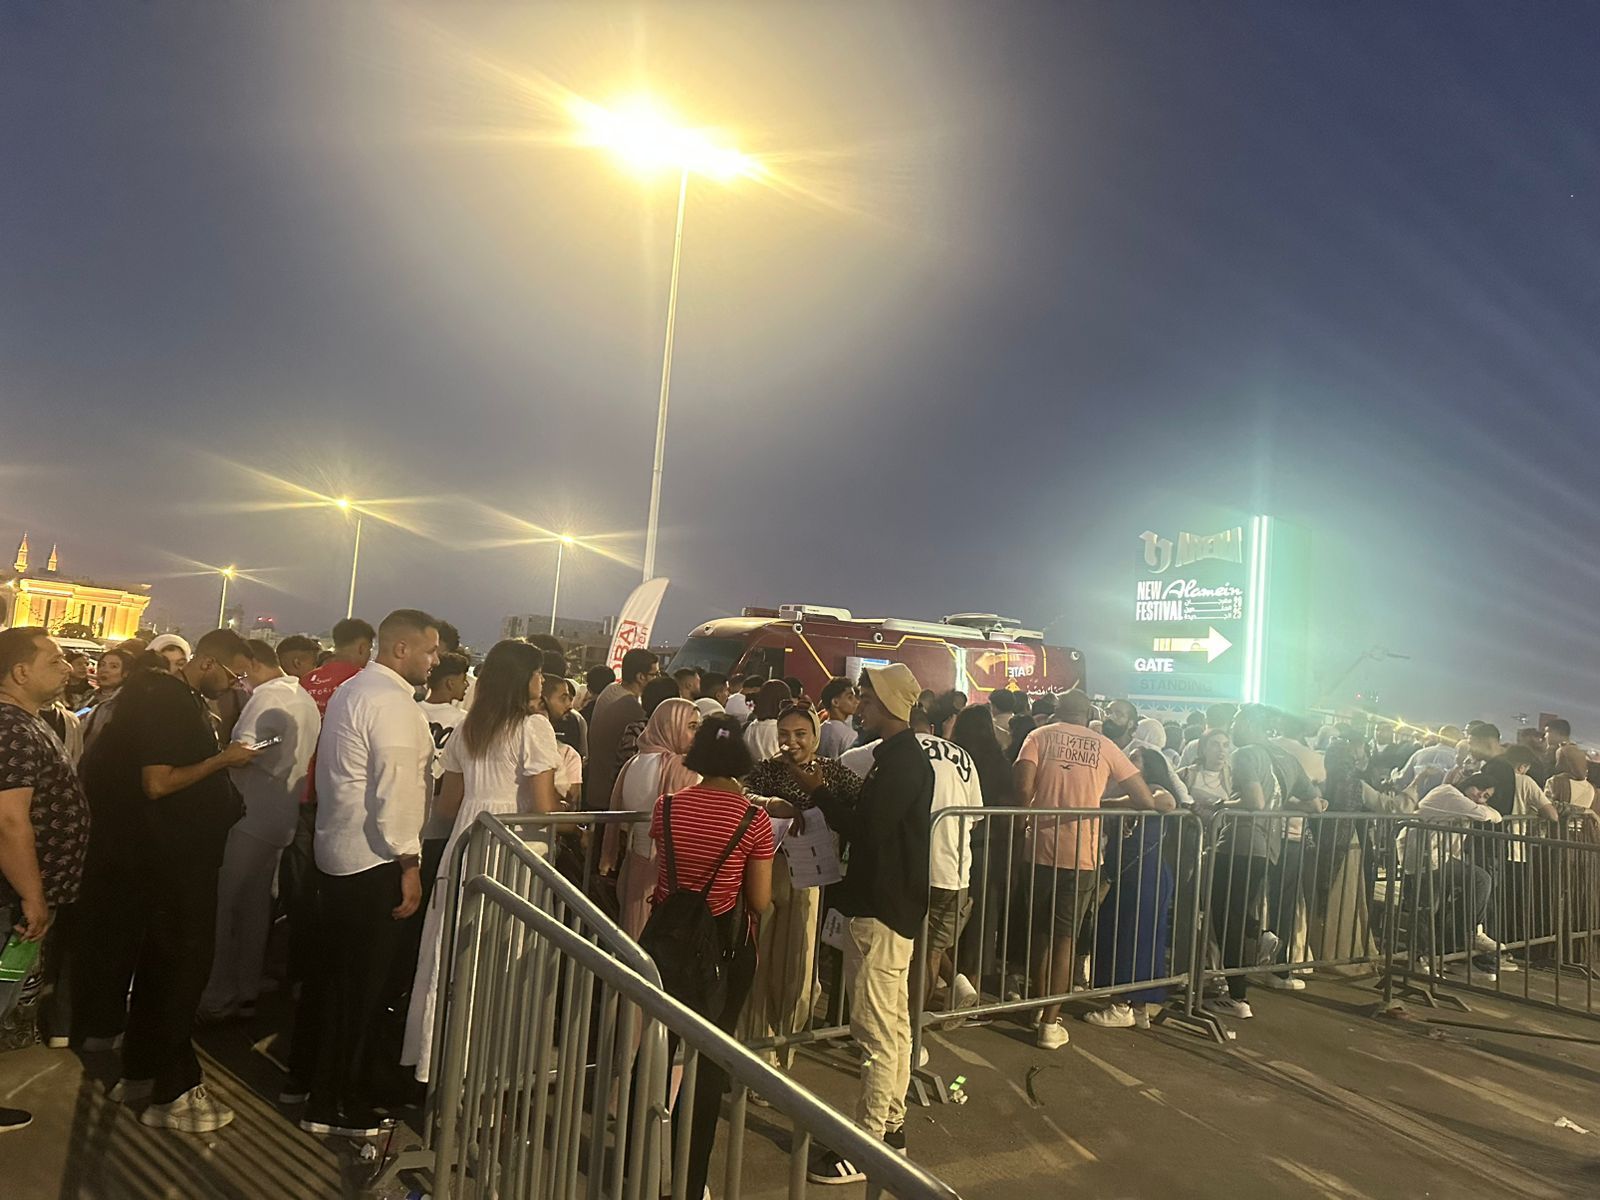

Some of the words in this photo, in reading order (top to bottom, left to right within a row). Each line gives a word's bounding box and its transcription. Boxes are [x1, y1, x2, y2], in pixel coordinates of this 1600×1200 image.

[1136, 581, 1163, 601] NEW
[1135, 600, 1184, 621] FESTIVAL
[1134, 658, 1174, 672] GATE
[1140, 679, 1213, 692] STANDING
[1047, 731, 1097, 752] LLISTER
